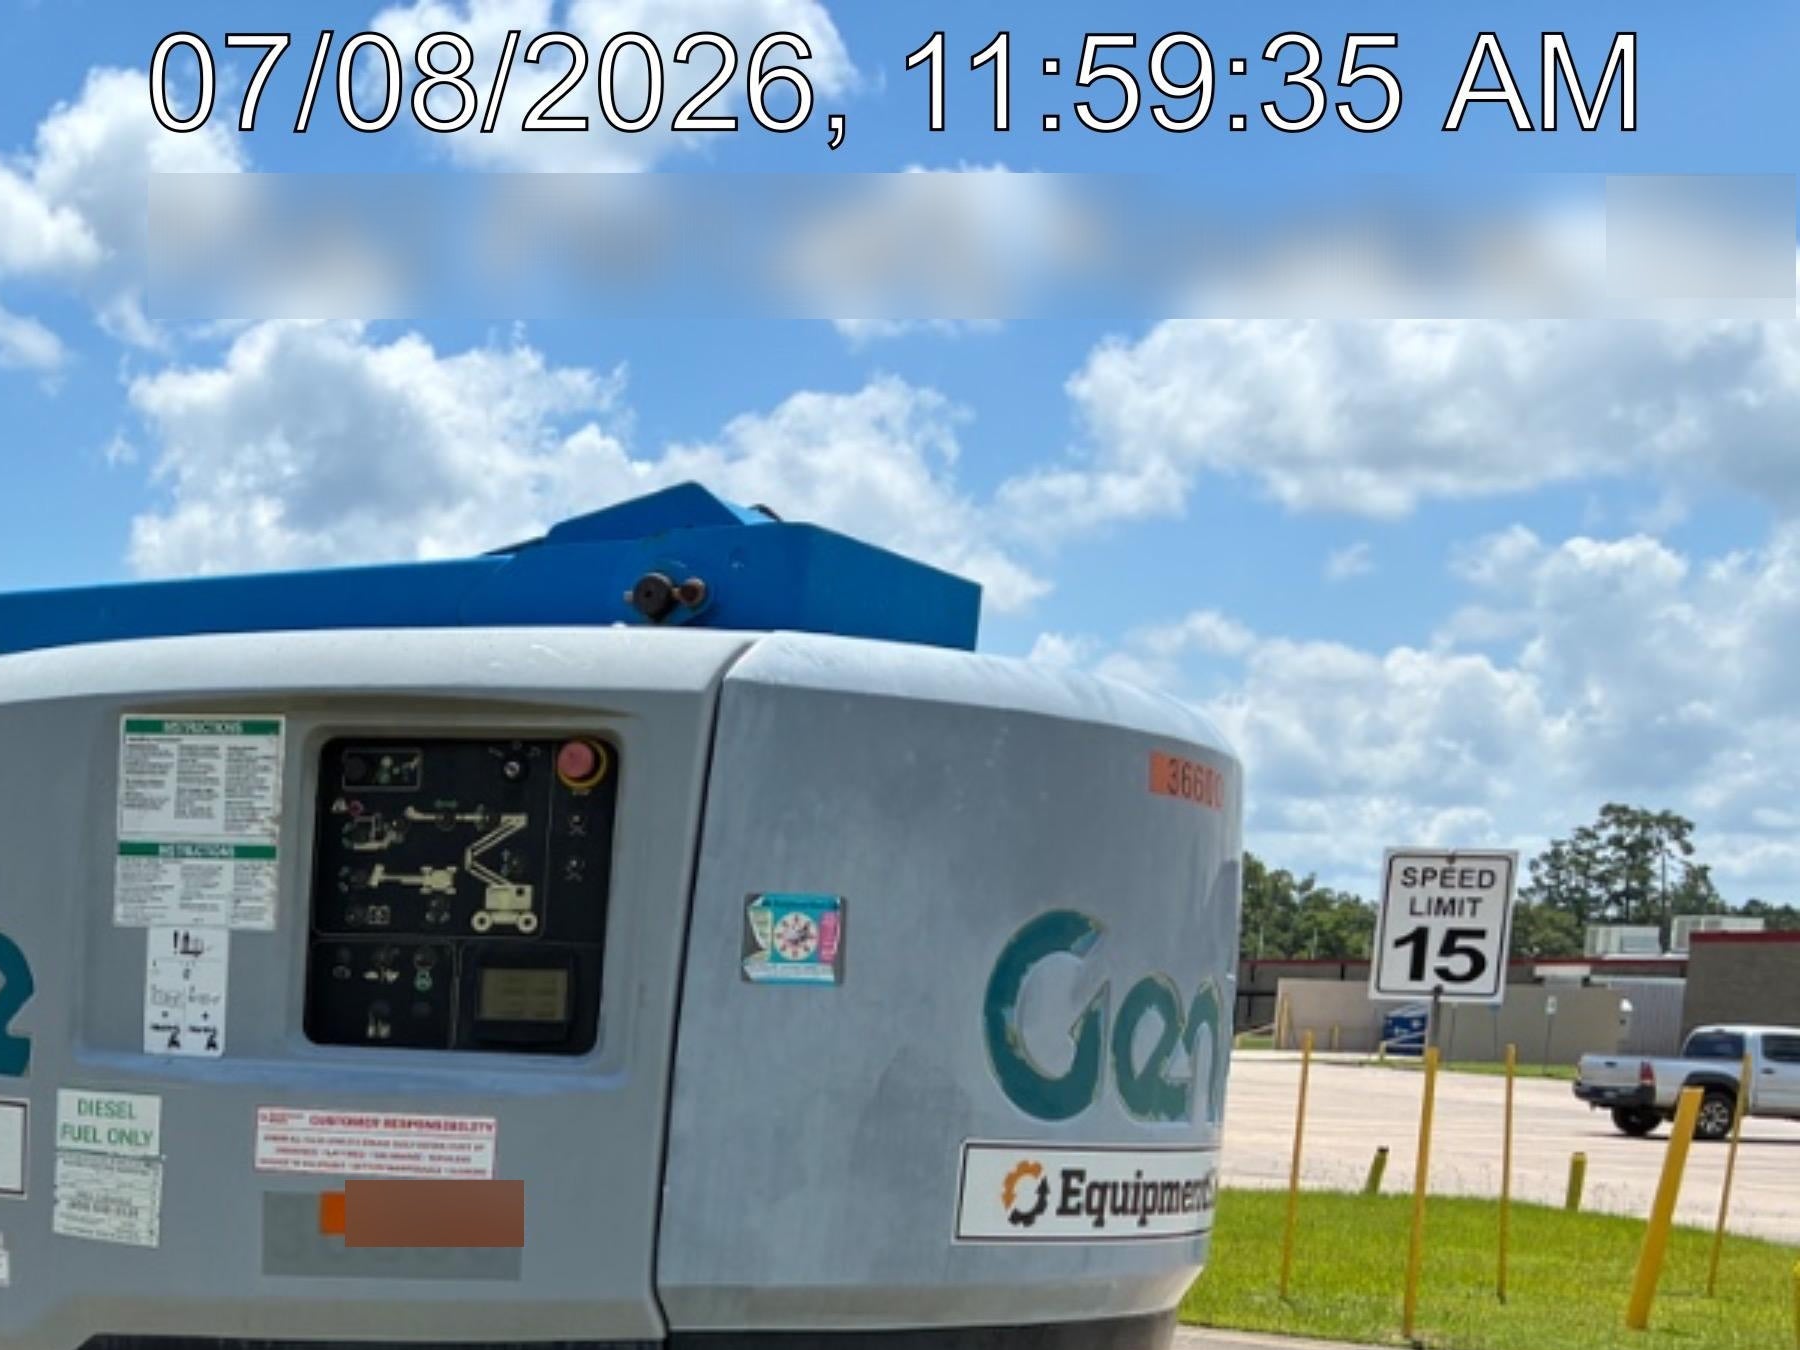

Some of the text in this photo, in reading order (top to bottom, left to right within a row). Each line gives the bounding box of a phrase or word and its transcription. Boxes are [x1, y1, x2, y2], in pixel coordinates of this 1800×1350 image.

[1400, 866, 1496, 889] SPEED
[1409, 896, 1483, 918] LIMIT
[1392, 926, 1487, 984] 15
[77, 1098, 137, 1120] DIESEL
[60, 1123, 153, 1147] FUEL ONLY
[1056, 1166, 1218, 1228] Equipment
